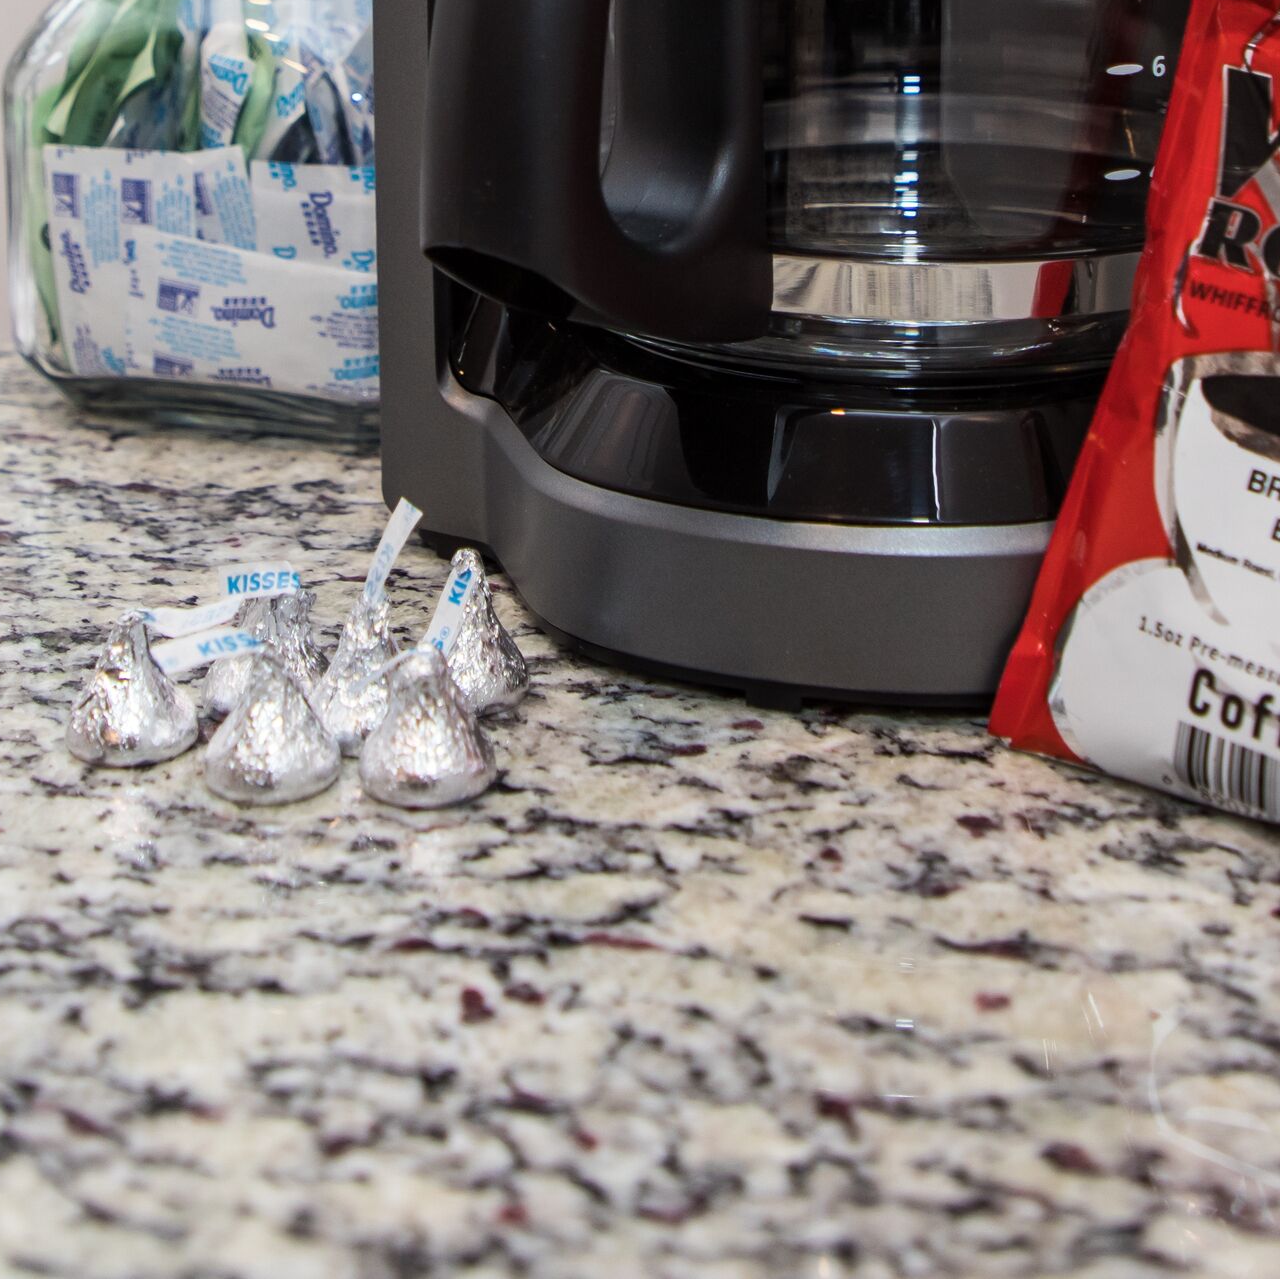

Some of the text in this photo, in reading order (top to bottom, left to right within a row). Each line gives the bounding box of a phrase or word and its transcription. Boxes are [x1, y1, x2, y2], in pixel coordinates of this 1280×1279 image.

[1151, 56, 1167, 77] 6
[226, 570, 302, 595] KISSES
[1137, 616, 1182, 647] 1.5oz
